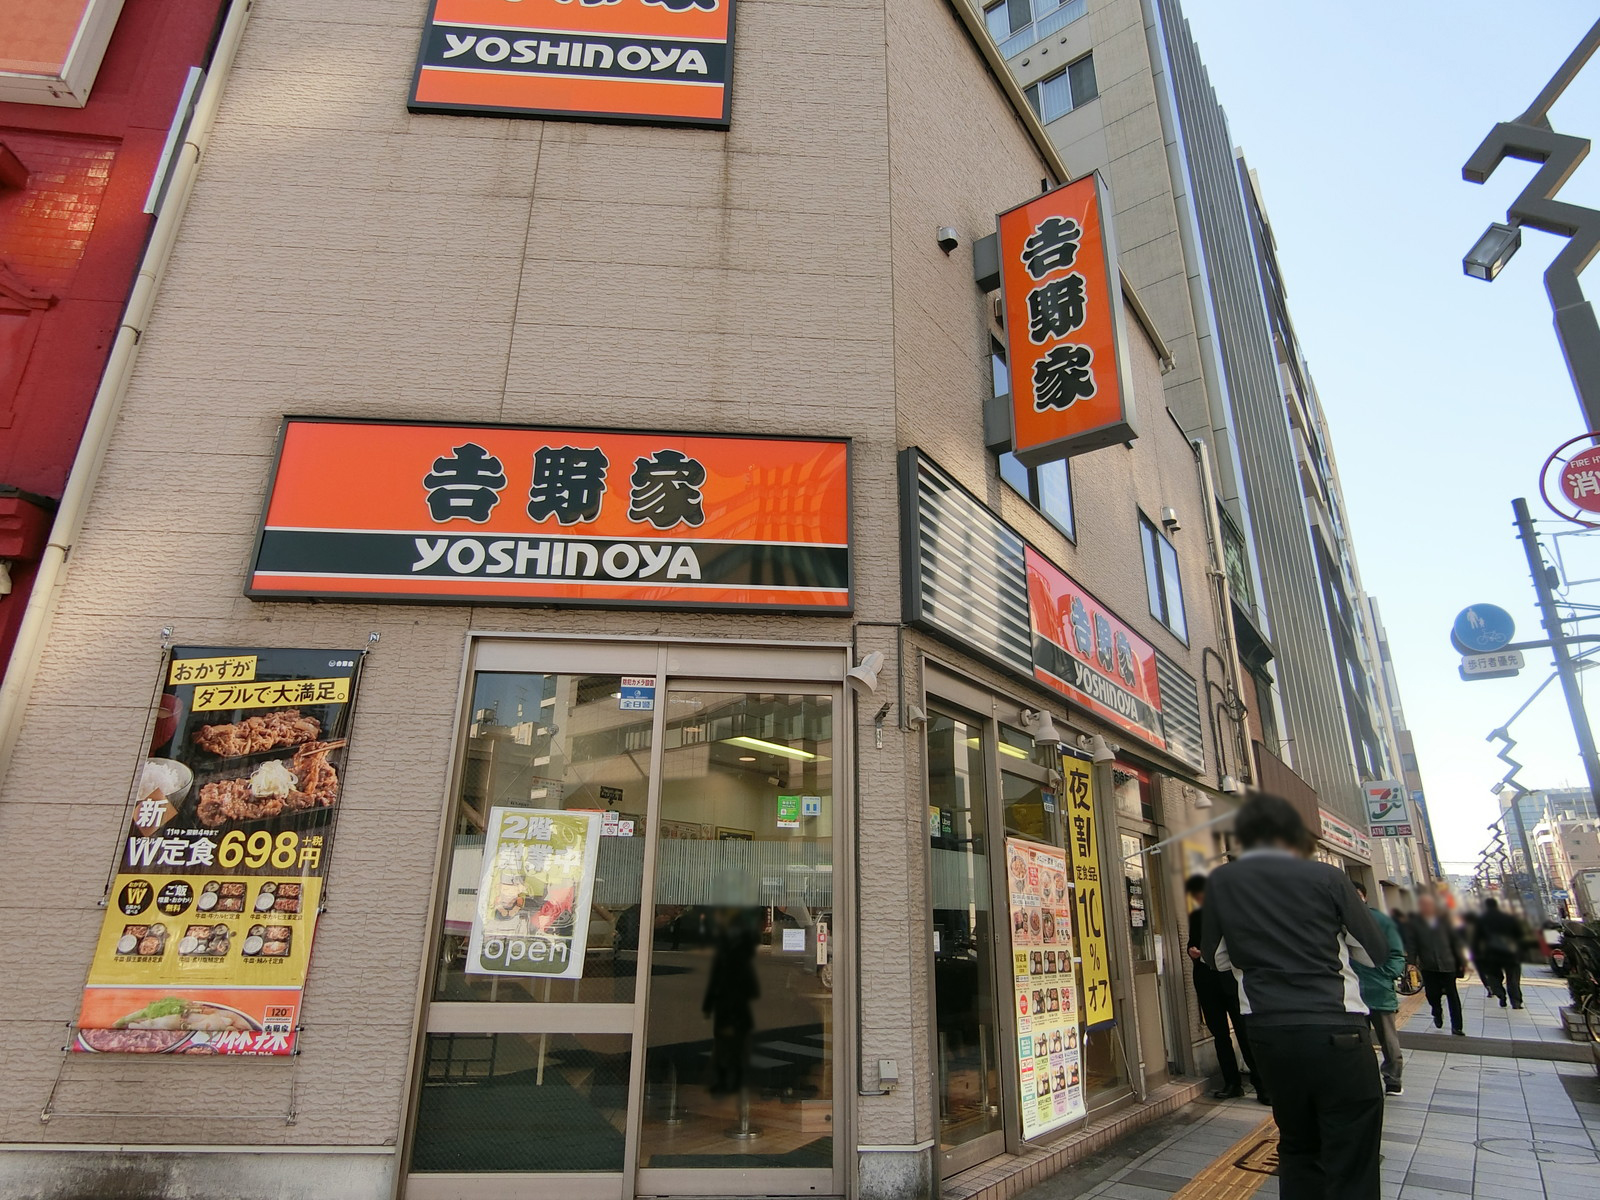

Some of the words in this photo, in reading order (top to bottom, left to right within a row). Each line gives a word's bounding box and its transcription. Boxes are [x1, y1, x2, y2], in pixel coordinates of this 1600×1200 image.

[443, 33, 708, 74] YOSHINOYA
[1020, 215, 1097, 413] 吉野家
[1570, 457, 1590, 469] FIRE
[422, 442, 707, 530] 吉野家
[1567, 470, 1600, 499] 消
[412, 537, 701, 580] YOSHINOYA
[1069, 595, 1136, 688] 吉野家
[174, 659, 253, 681] おかずが
[1468, 655, 1518, 670] 歩行者優先
[198, 681, 345, 708] ダブルで大満足。
[1074, 660, 1139, 722] YOSHINOYA
[136, 798, 168, 828] 新
[500, 815, 554, 841] 2階
[165, 884, 188, 897] ご飯
[484, 938, 567, 967] open
[1088, 978, 1108, 1011] オフ
